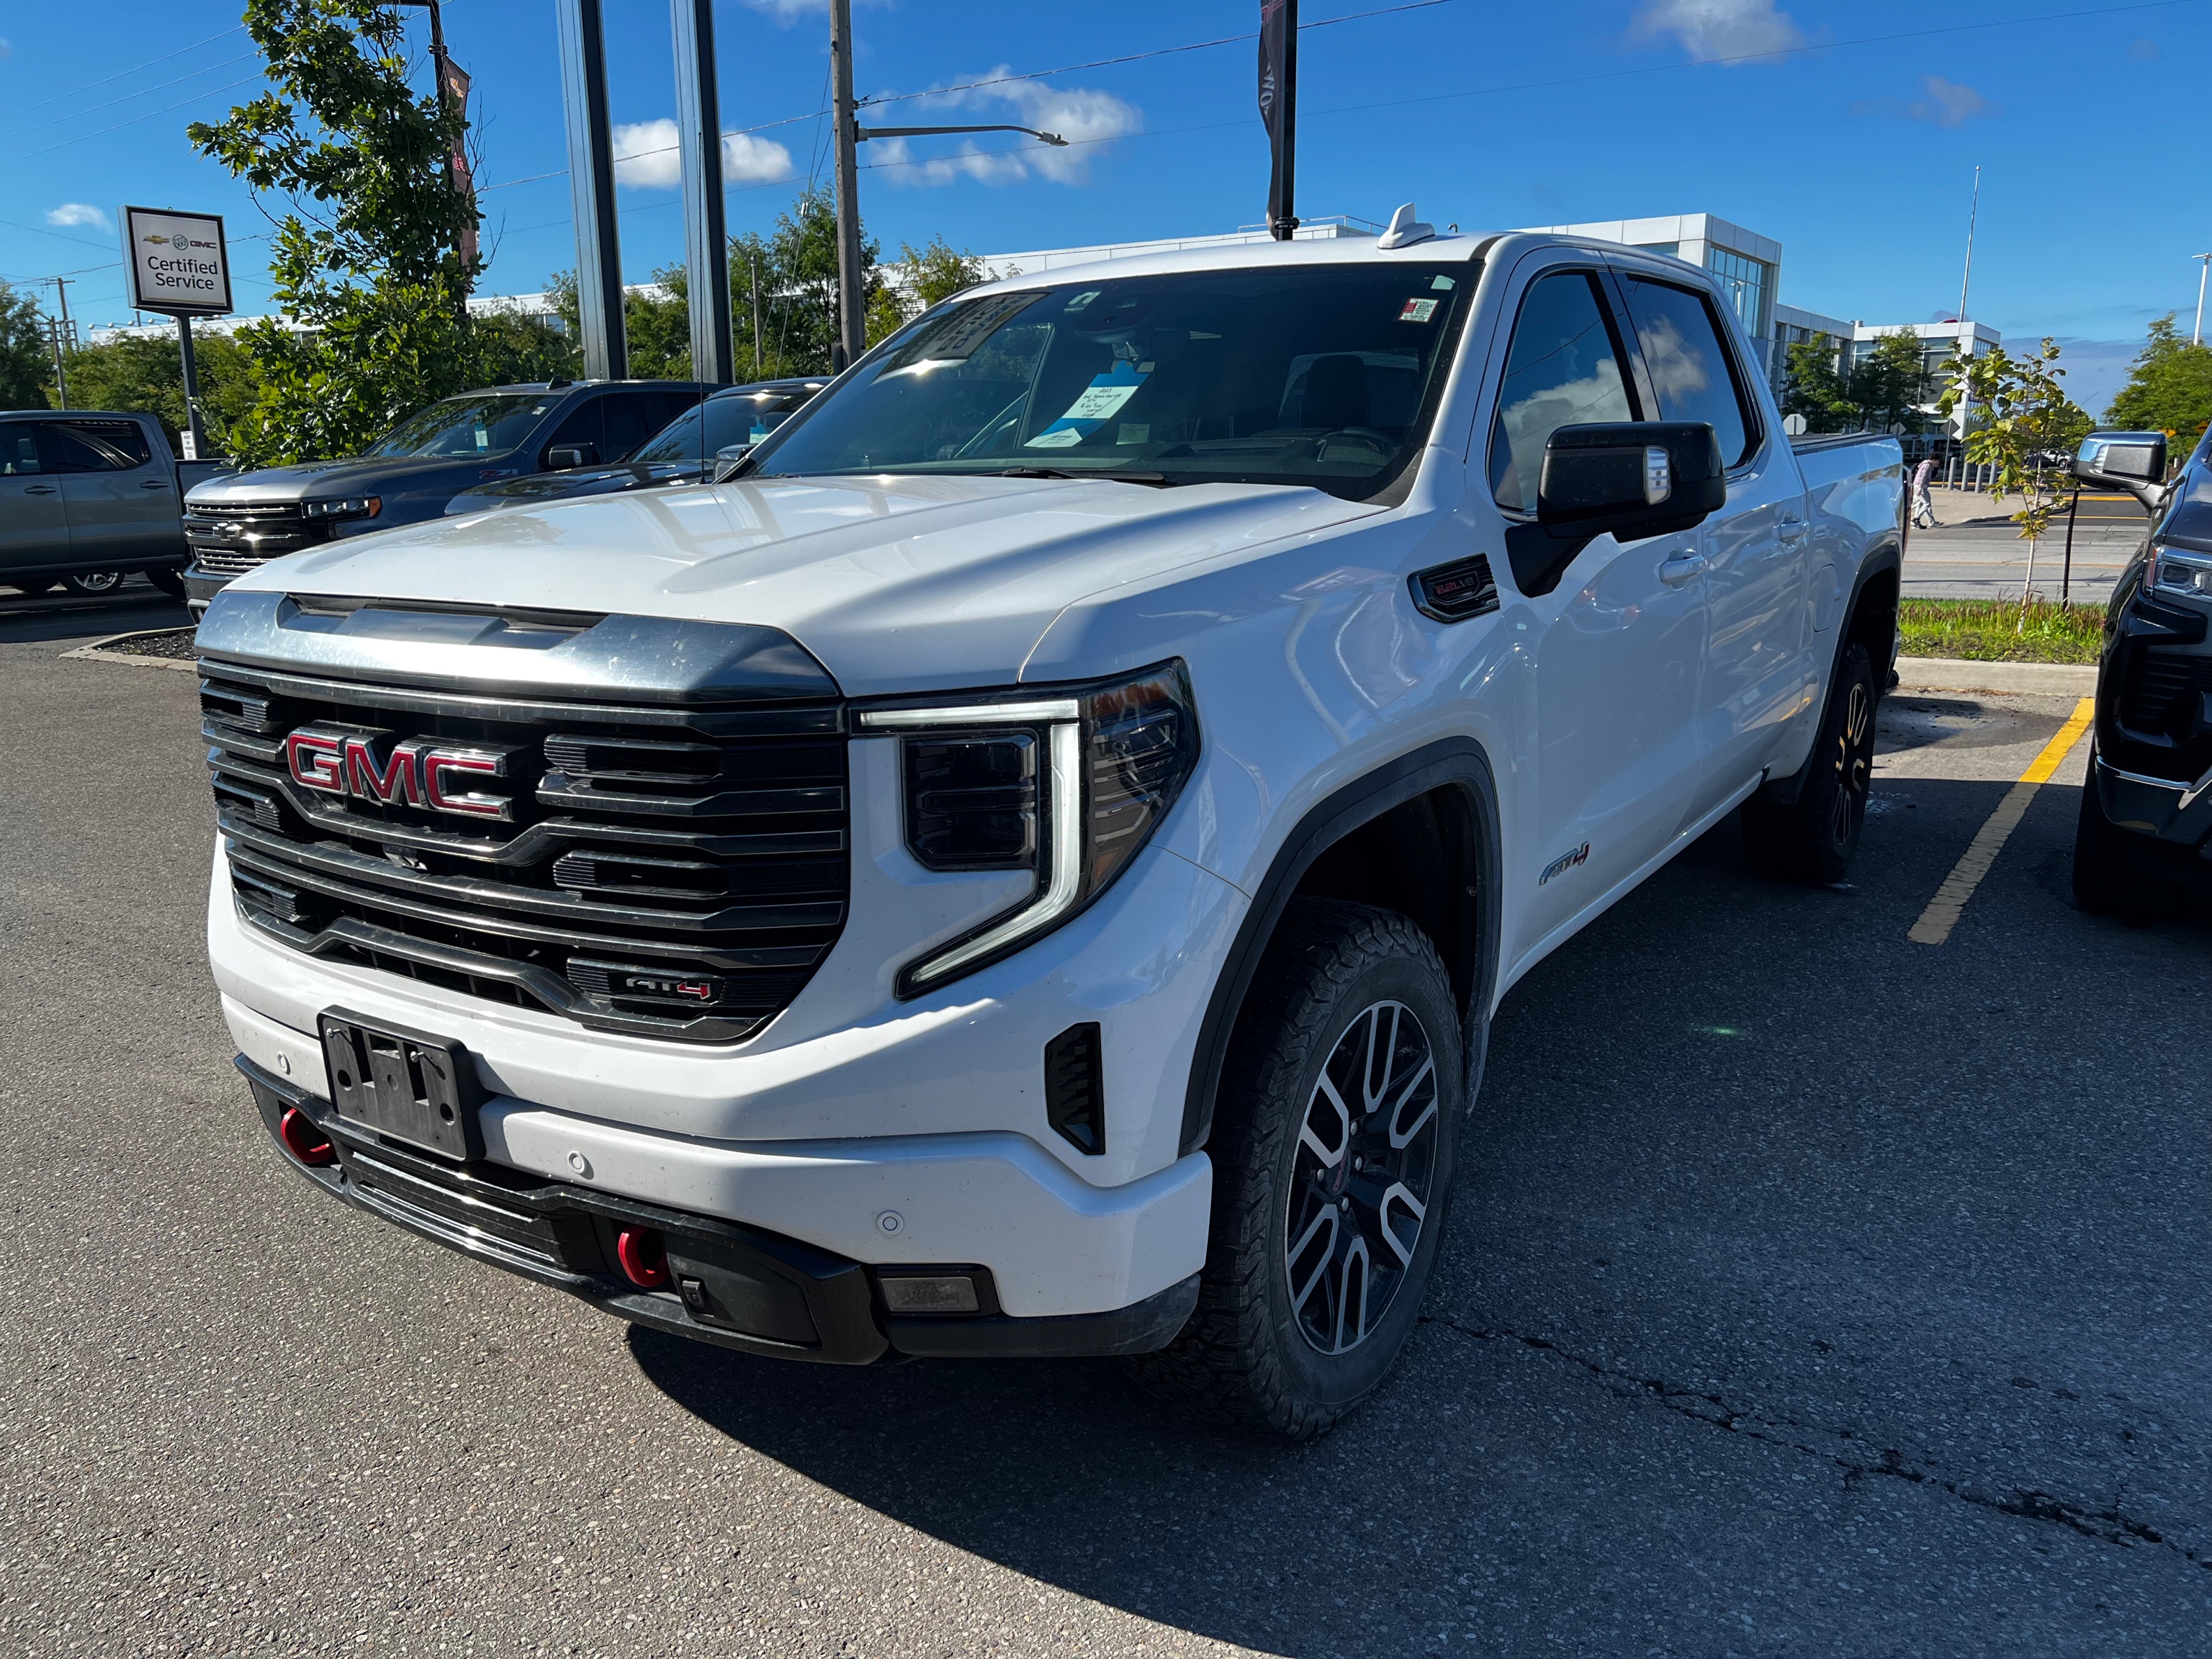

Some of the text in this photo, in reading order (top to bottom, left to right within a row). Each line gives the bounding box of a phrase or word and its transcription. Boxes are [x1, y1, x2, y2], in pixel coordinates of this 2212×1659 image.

[189, 240, 217, 249] GMC
[148, 256, 218, 275] Certified
[155, 272, 215, 290] Service
[478, 468, 518, 480] Z71
[288, 726, 516, 823] GMC
[1539, 840, 1590, 886] AT4
[626, 975, 711, 1000] AT4
